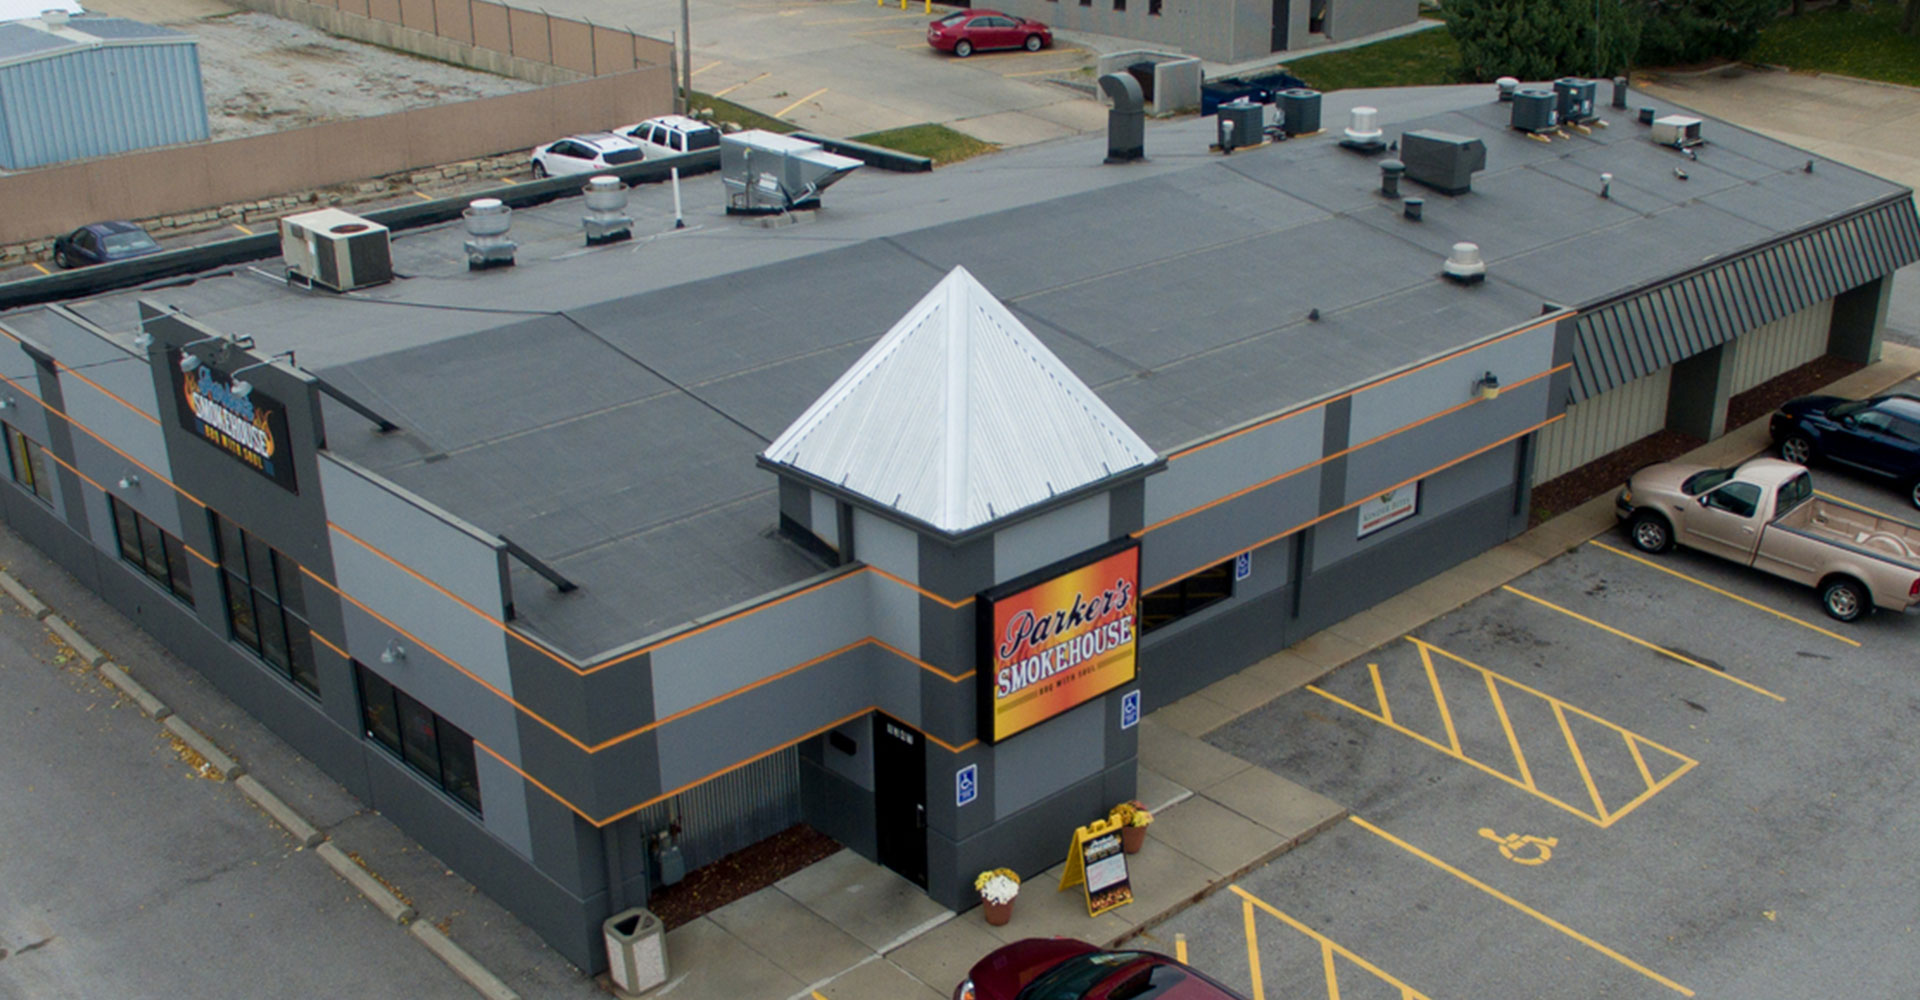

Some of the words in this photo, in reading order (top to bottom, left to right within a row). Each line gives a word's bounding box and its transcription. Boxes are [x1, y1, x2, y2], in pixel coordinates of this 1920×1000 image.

[193, 391, 270, 459] SMOKEHOUSE
[221, 434, 241, 457] WITH
[243, 447, 264, 470] SOUL
[1000, 578, 1132, 660] Parker's
[997, 615, 1133, 699] SMOKEHOUSE
[1056, 673, 1075, 689] WITH
